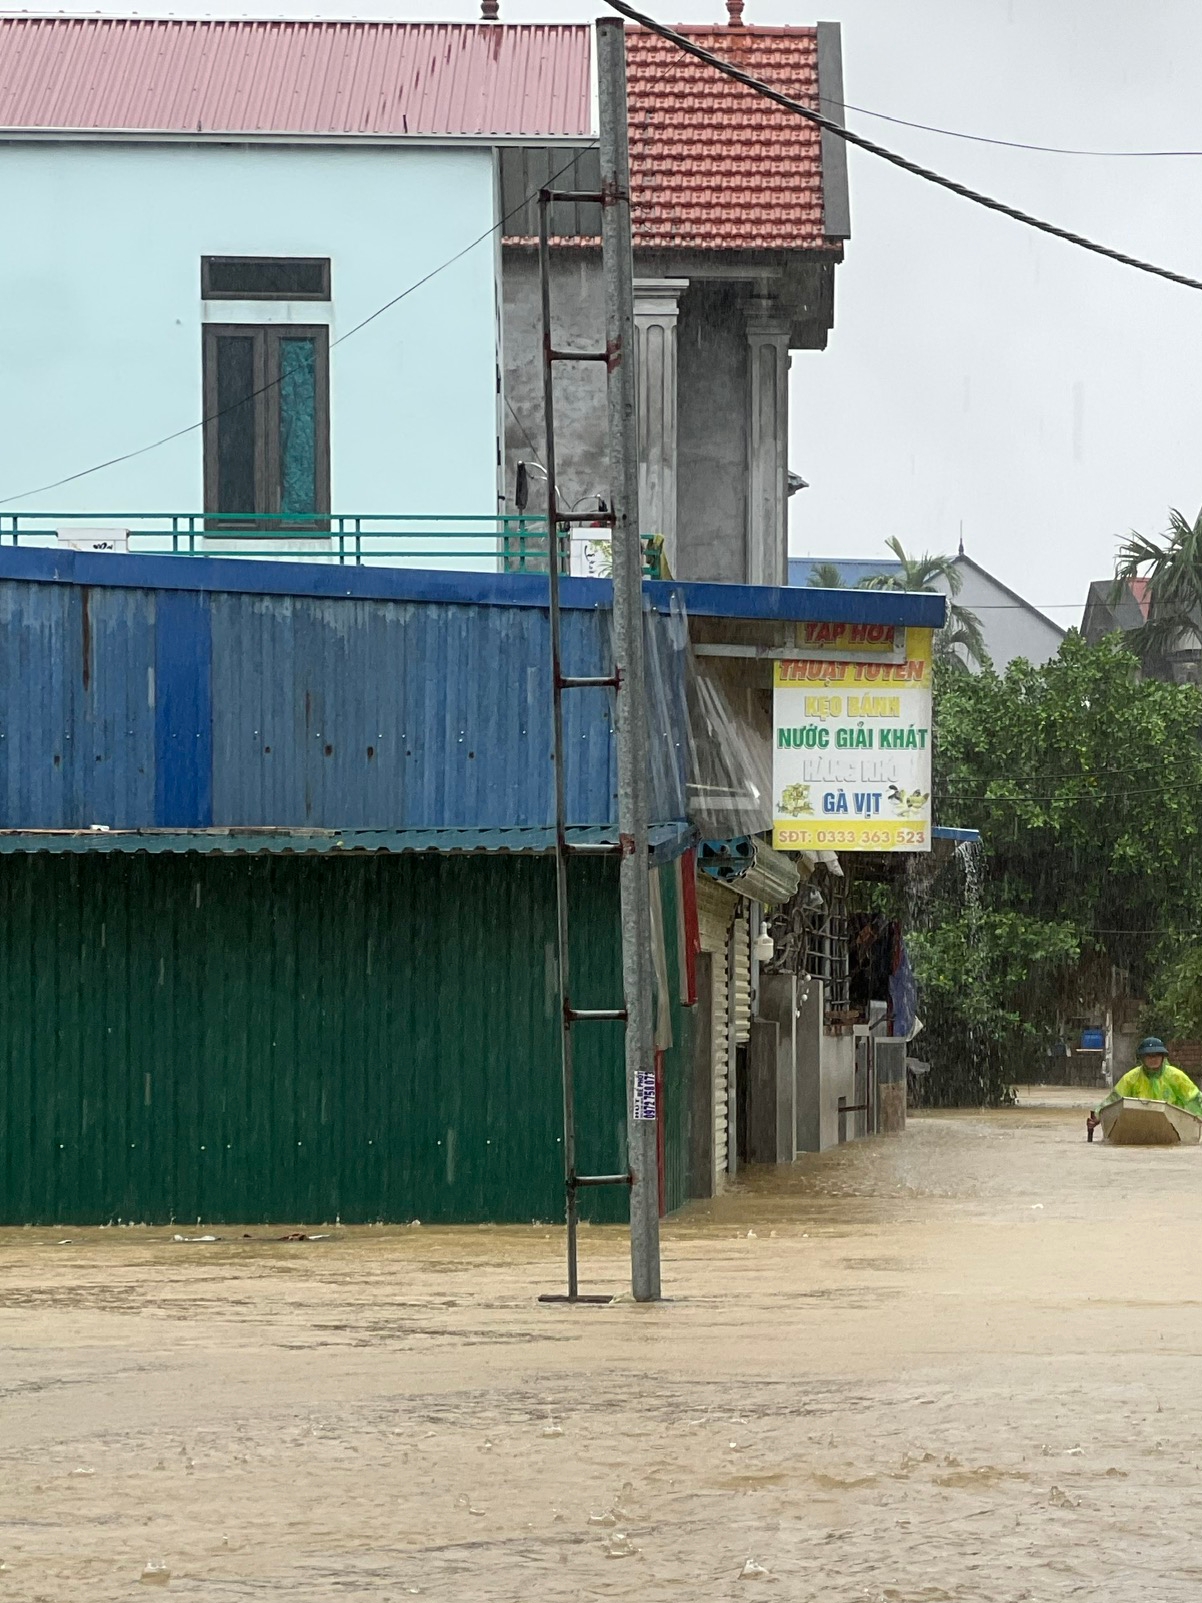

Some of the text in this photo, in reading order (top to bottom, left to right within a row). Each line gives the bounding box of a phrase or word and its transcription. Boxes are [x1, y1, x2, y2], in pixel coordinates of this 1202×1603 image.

[805, 692, 900, 721] KẸO BÁNH
[777, 721, 928, 750] NƯỚC GIẢI KHÁT
[822, 788, 882, 819] GÀ VỊT
[779, 830, 925, 843] SĐT: 0333 363 523
